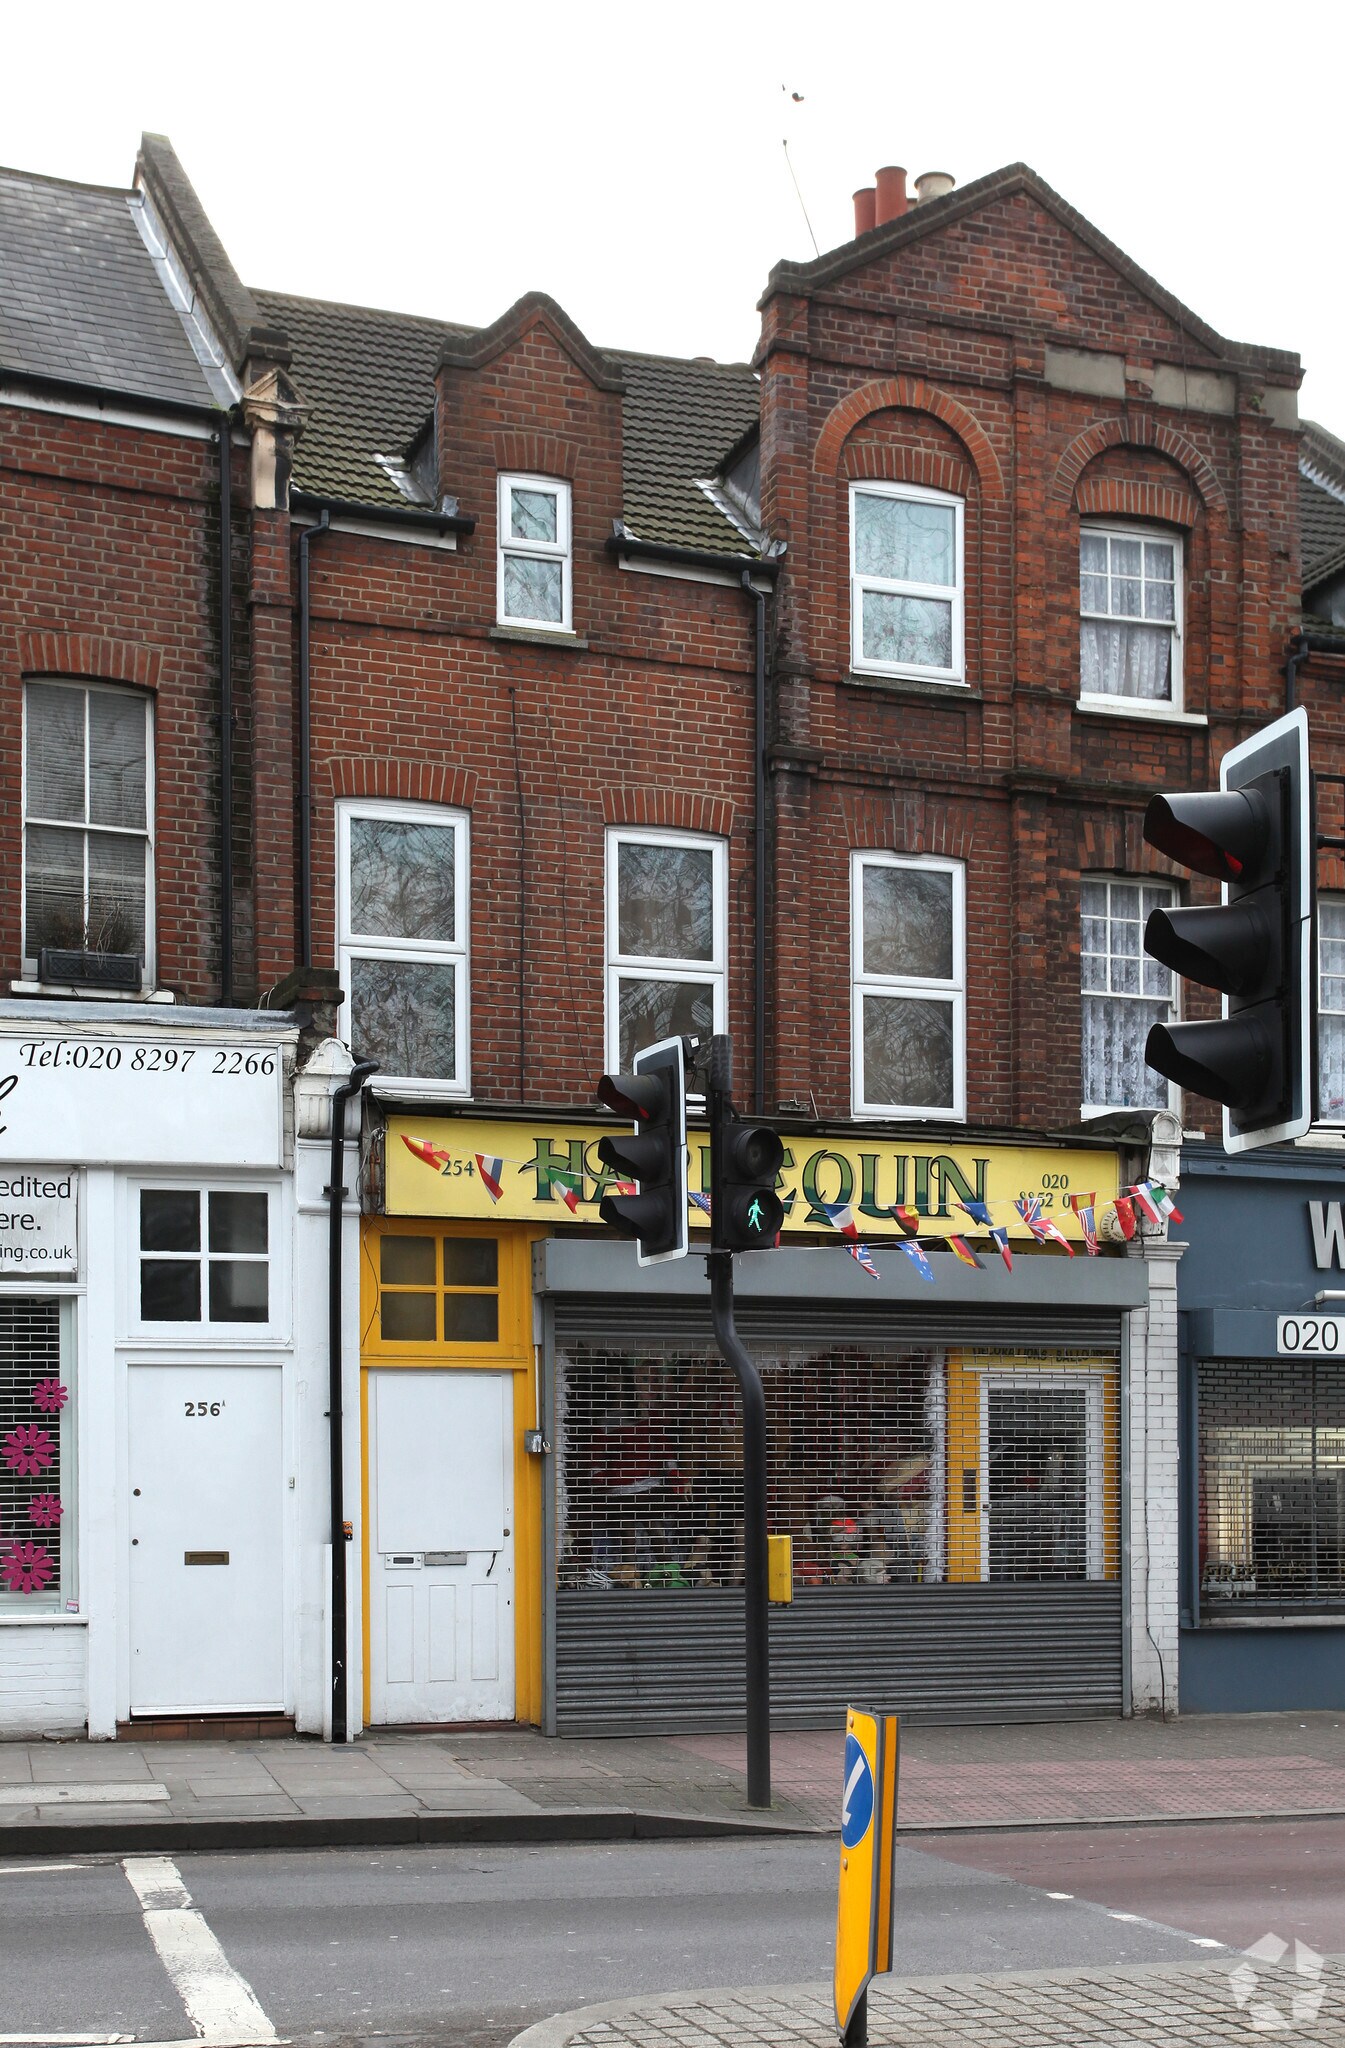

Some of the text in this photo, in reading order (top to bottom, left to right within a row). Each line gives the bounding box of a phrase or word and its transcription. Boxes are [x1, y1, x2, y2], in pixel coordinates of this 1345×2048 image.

[19, 1041, 277, 1076] Tel:020 8297 2266
[441, 1160, 475, 1177] 254
[517, 1138, 988, 1226] HAQUIN
[1041, 1173, 1069, 1190] 020
[1281, 1319, 1339, 1352] 020
